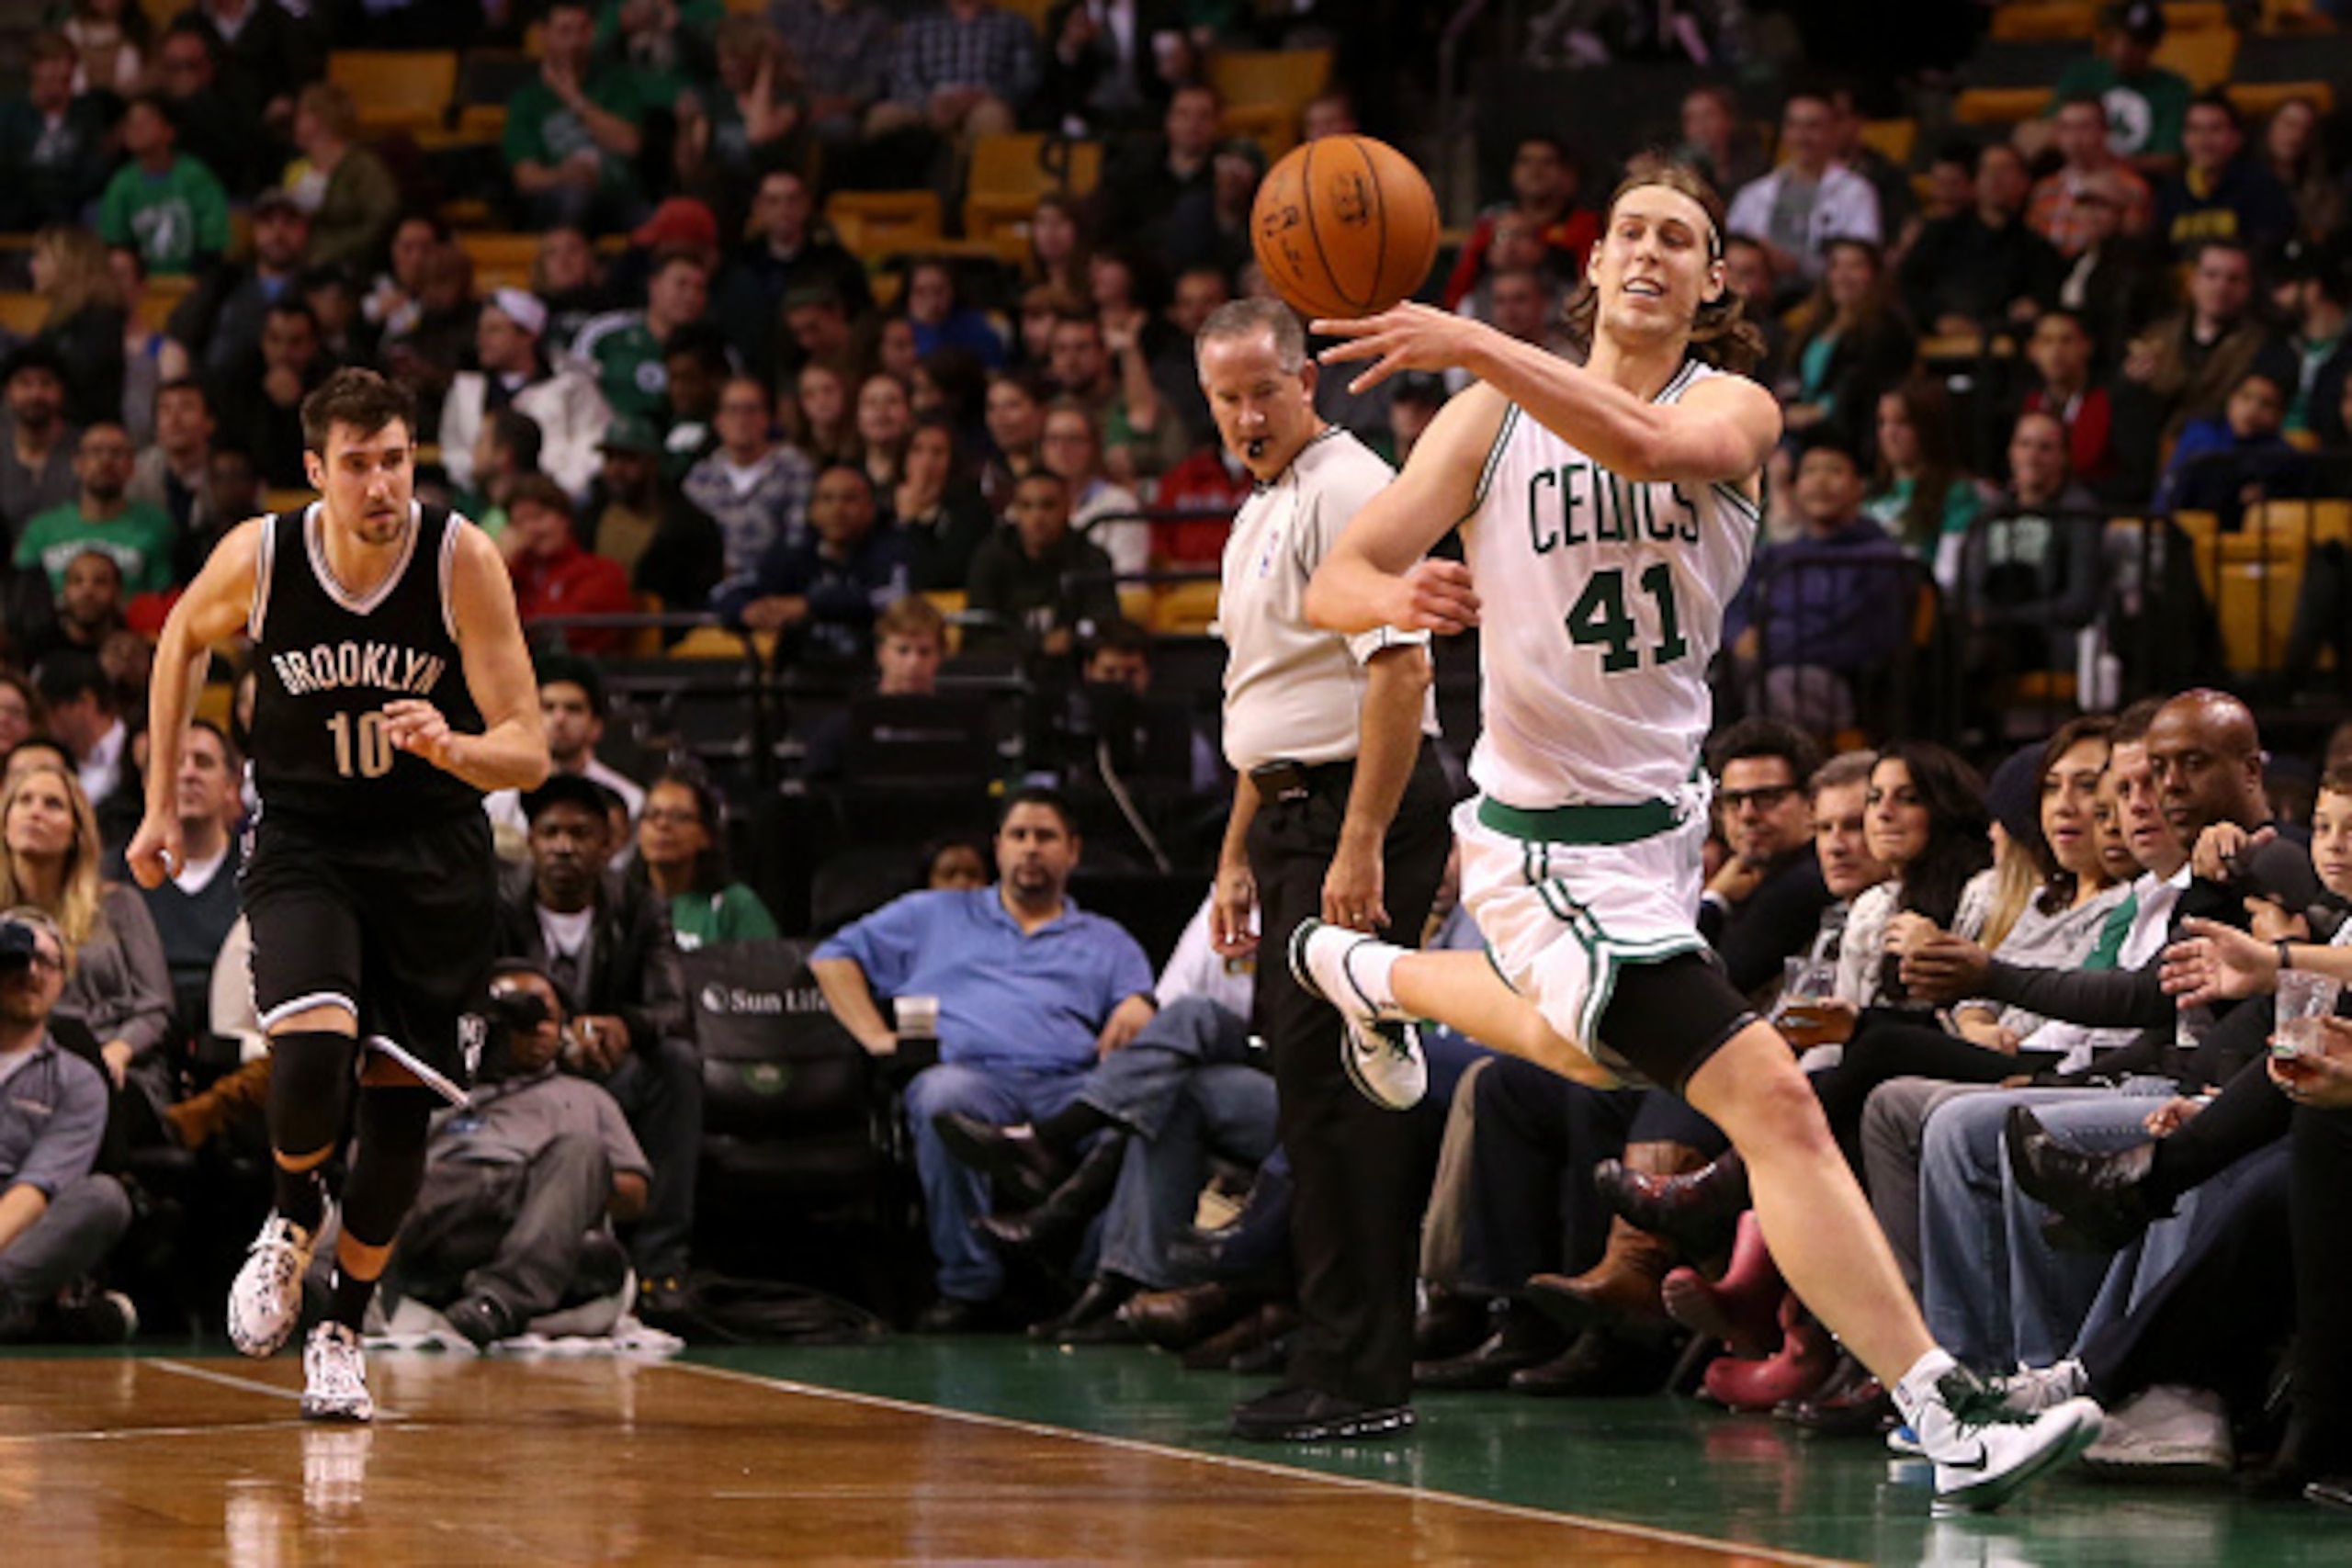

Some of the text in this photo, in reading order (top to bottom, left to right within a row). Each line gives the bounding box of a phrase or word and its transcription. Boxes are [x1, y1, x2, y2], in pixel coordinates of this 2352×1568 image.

[1565, 562, 1687, 673] 41
[271, 639, 447, 695] BROOKLYN
[326, 709, 394, 778] 10
[731, 987, 782, 1014] Sun
